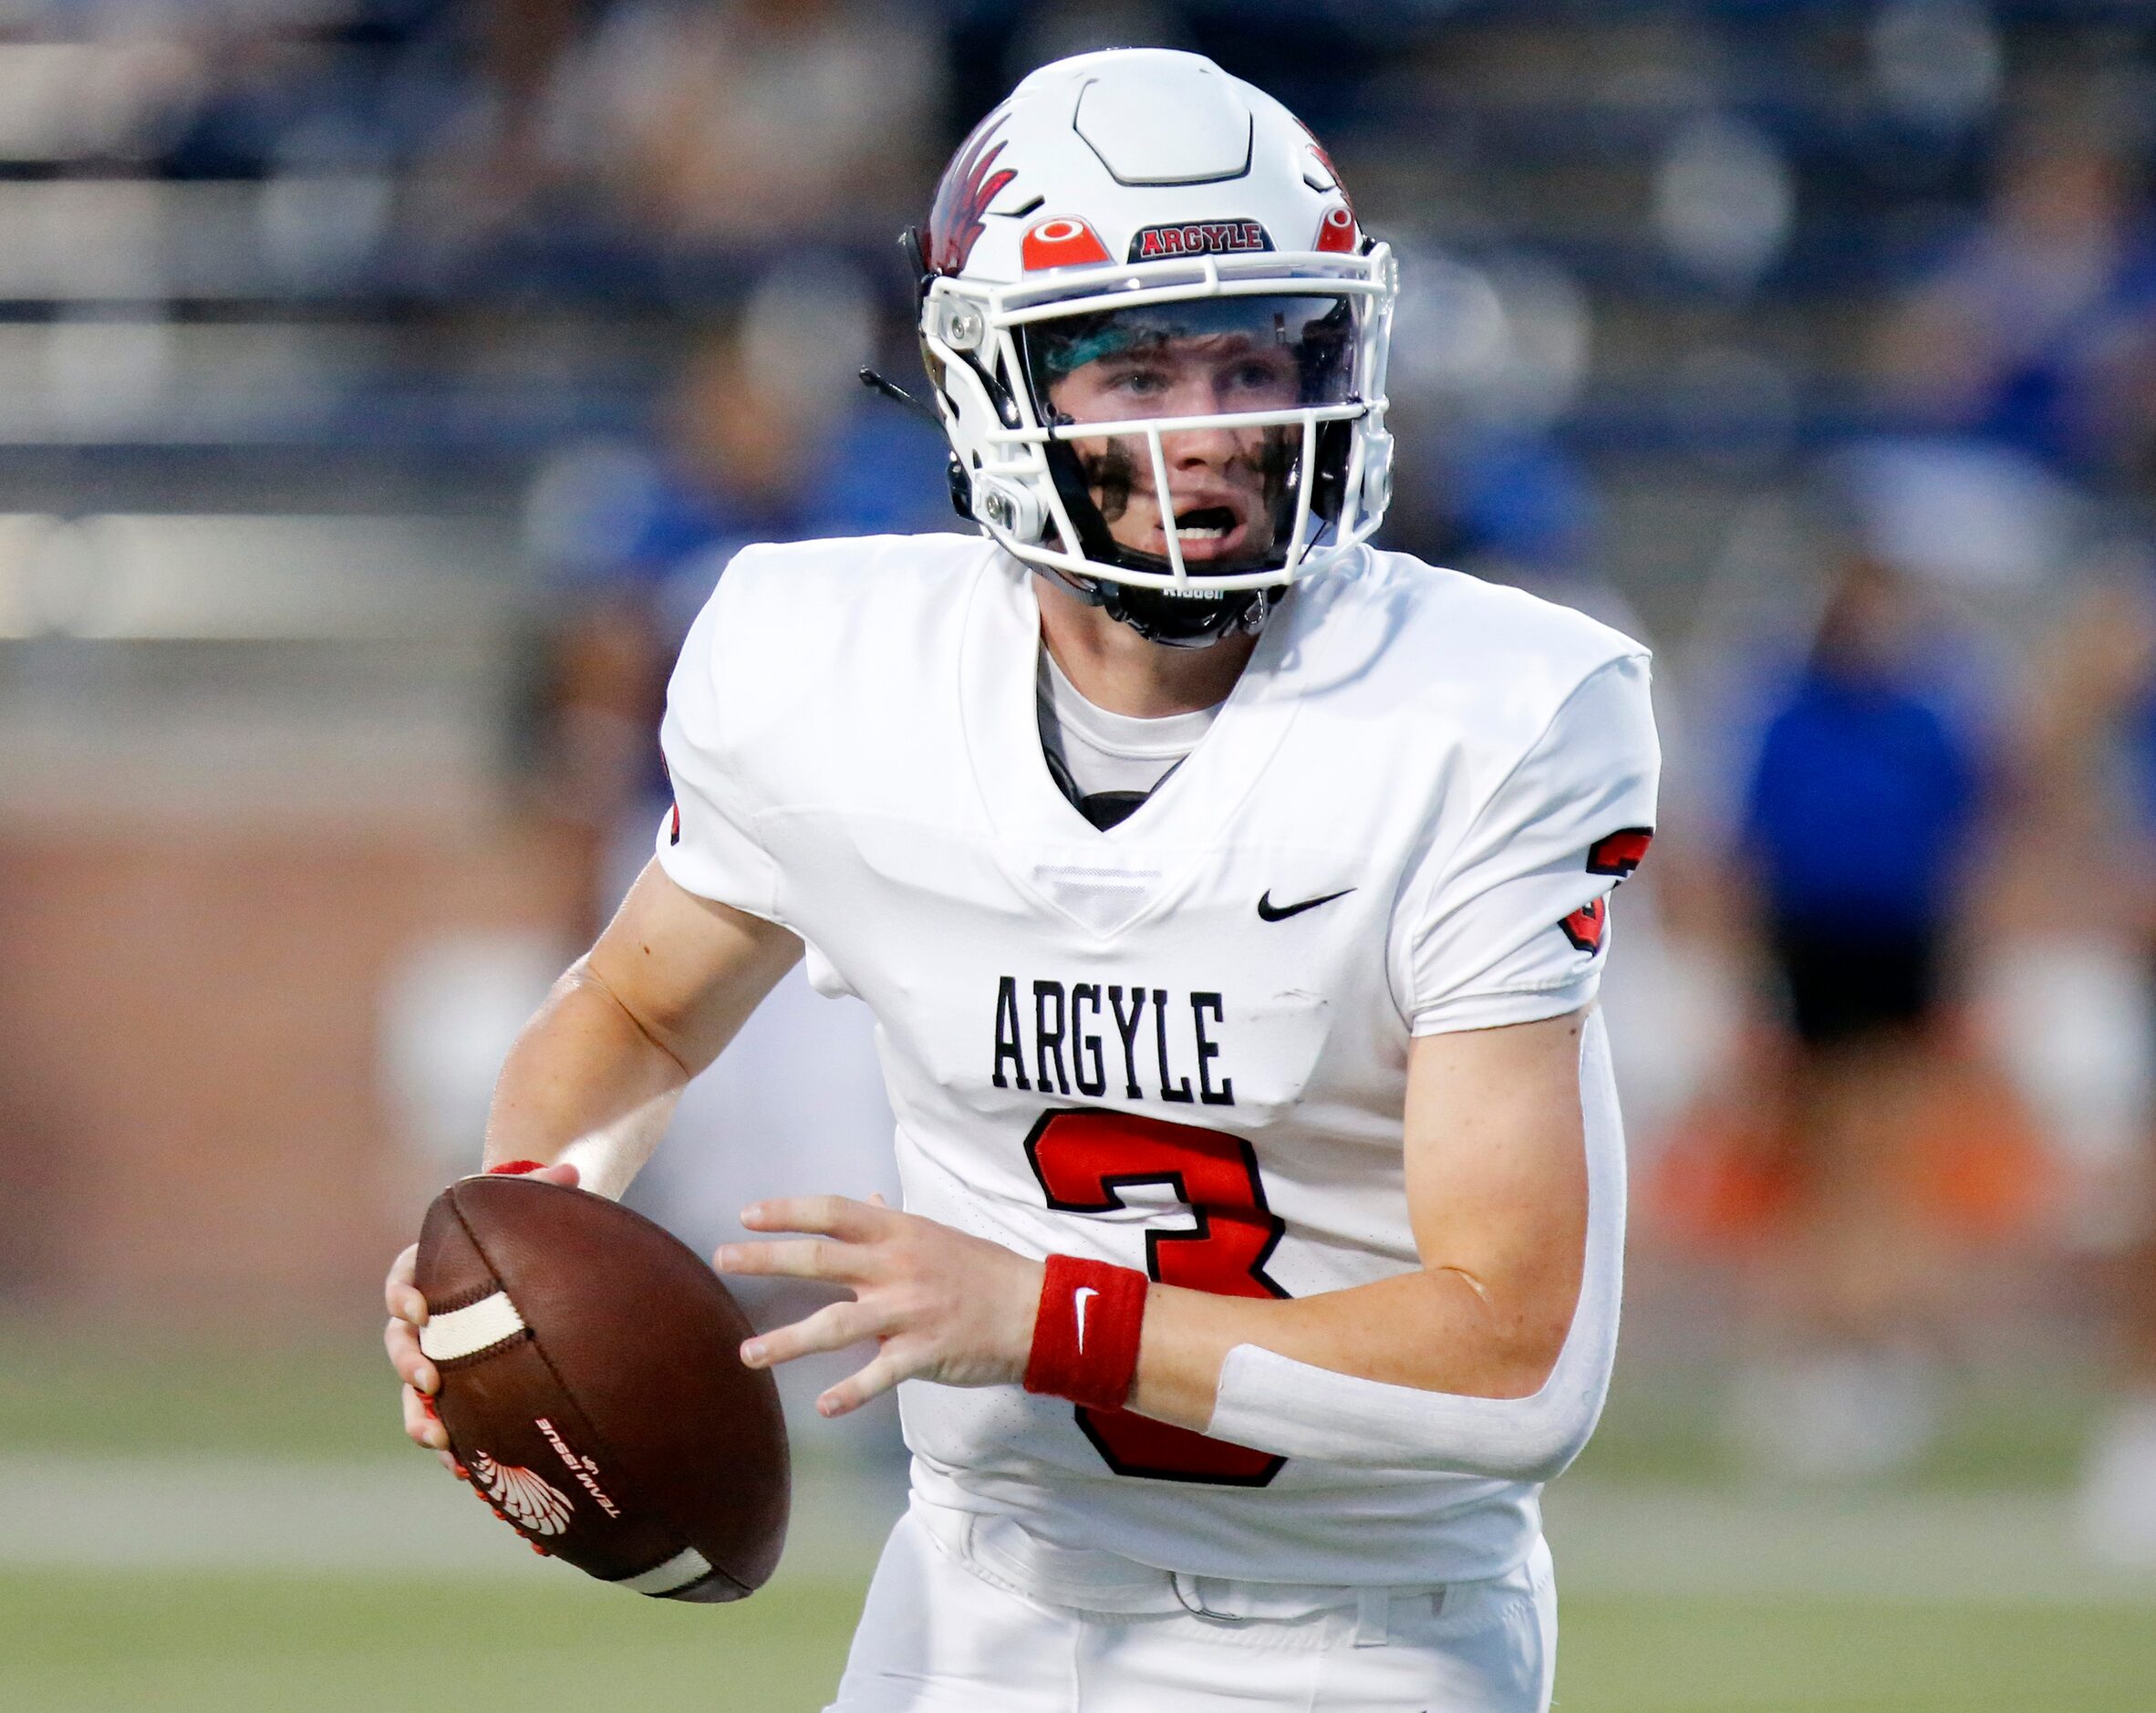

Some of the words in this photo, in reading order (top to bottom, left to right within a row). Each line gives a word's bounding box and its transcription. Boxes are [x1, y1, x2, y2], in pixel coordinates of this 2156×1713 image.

[1141, 223, 1264, 258] ARGYLE
[992, 975, 1235, 1106] ARGYLE
[1023, 1106, 1295, 1488] 3
[534, 1417, 583, 1470] ISSUE
[575, 1472, 621, 1519] TEAM
